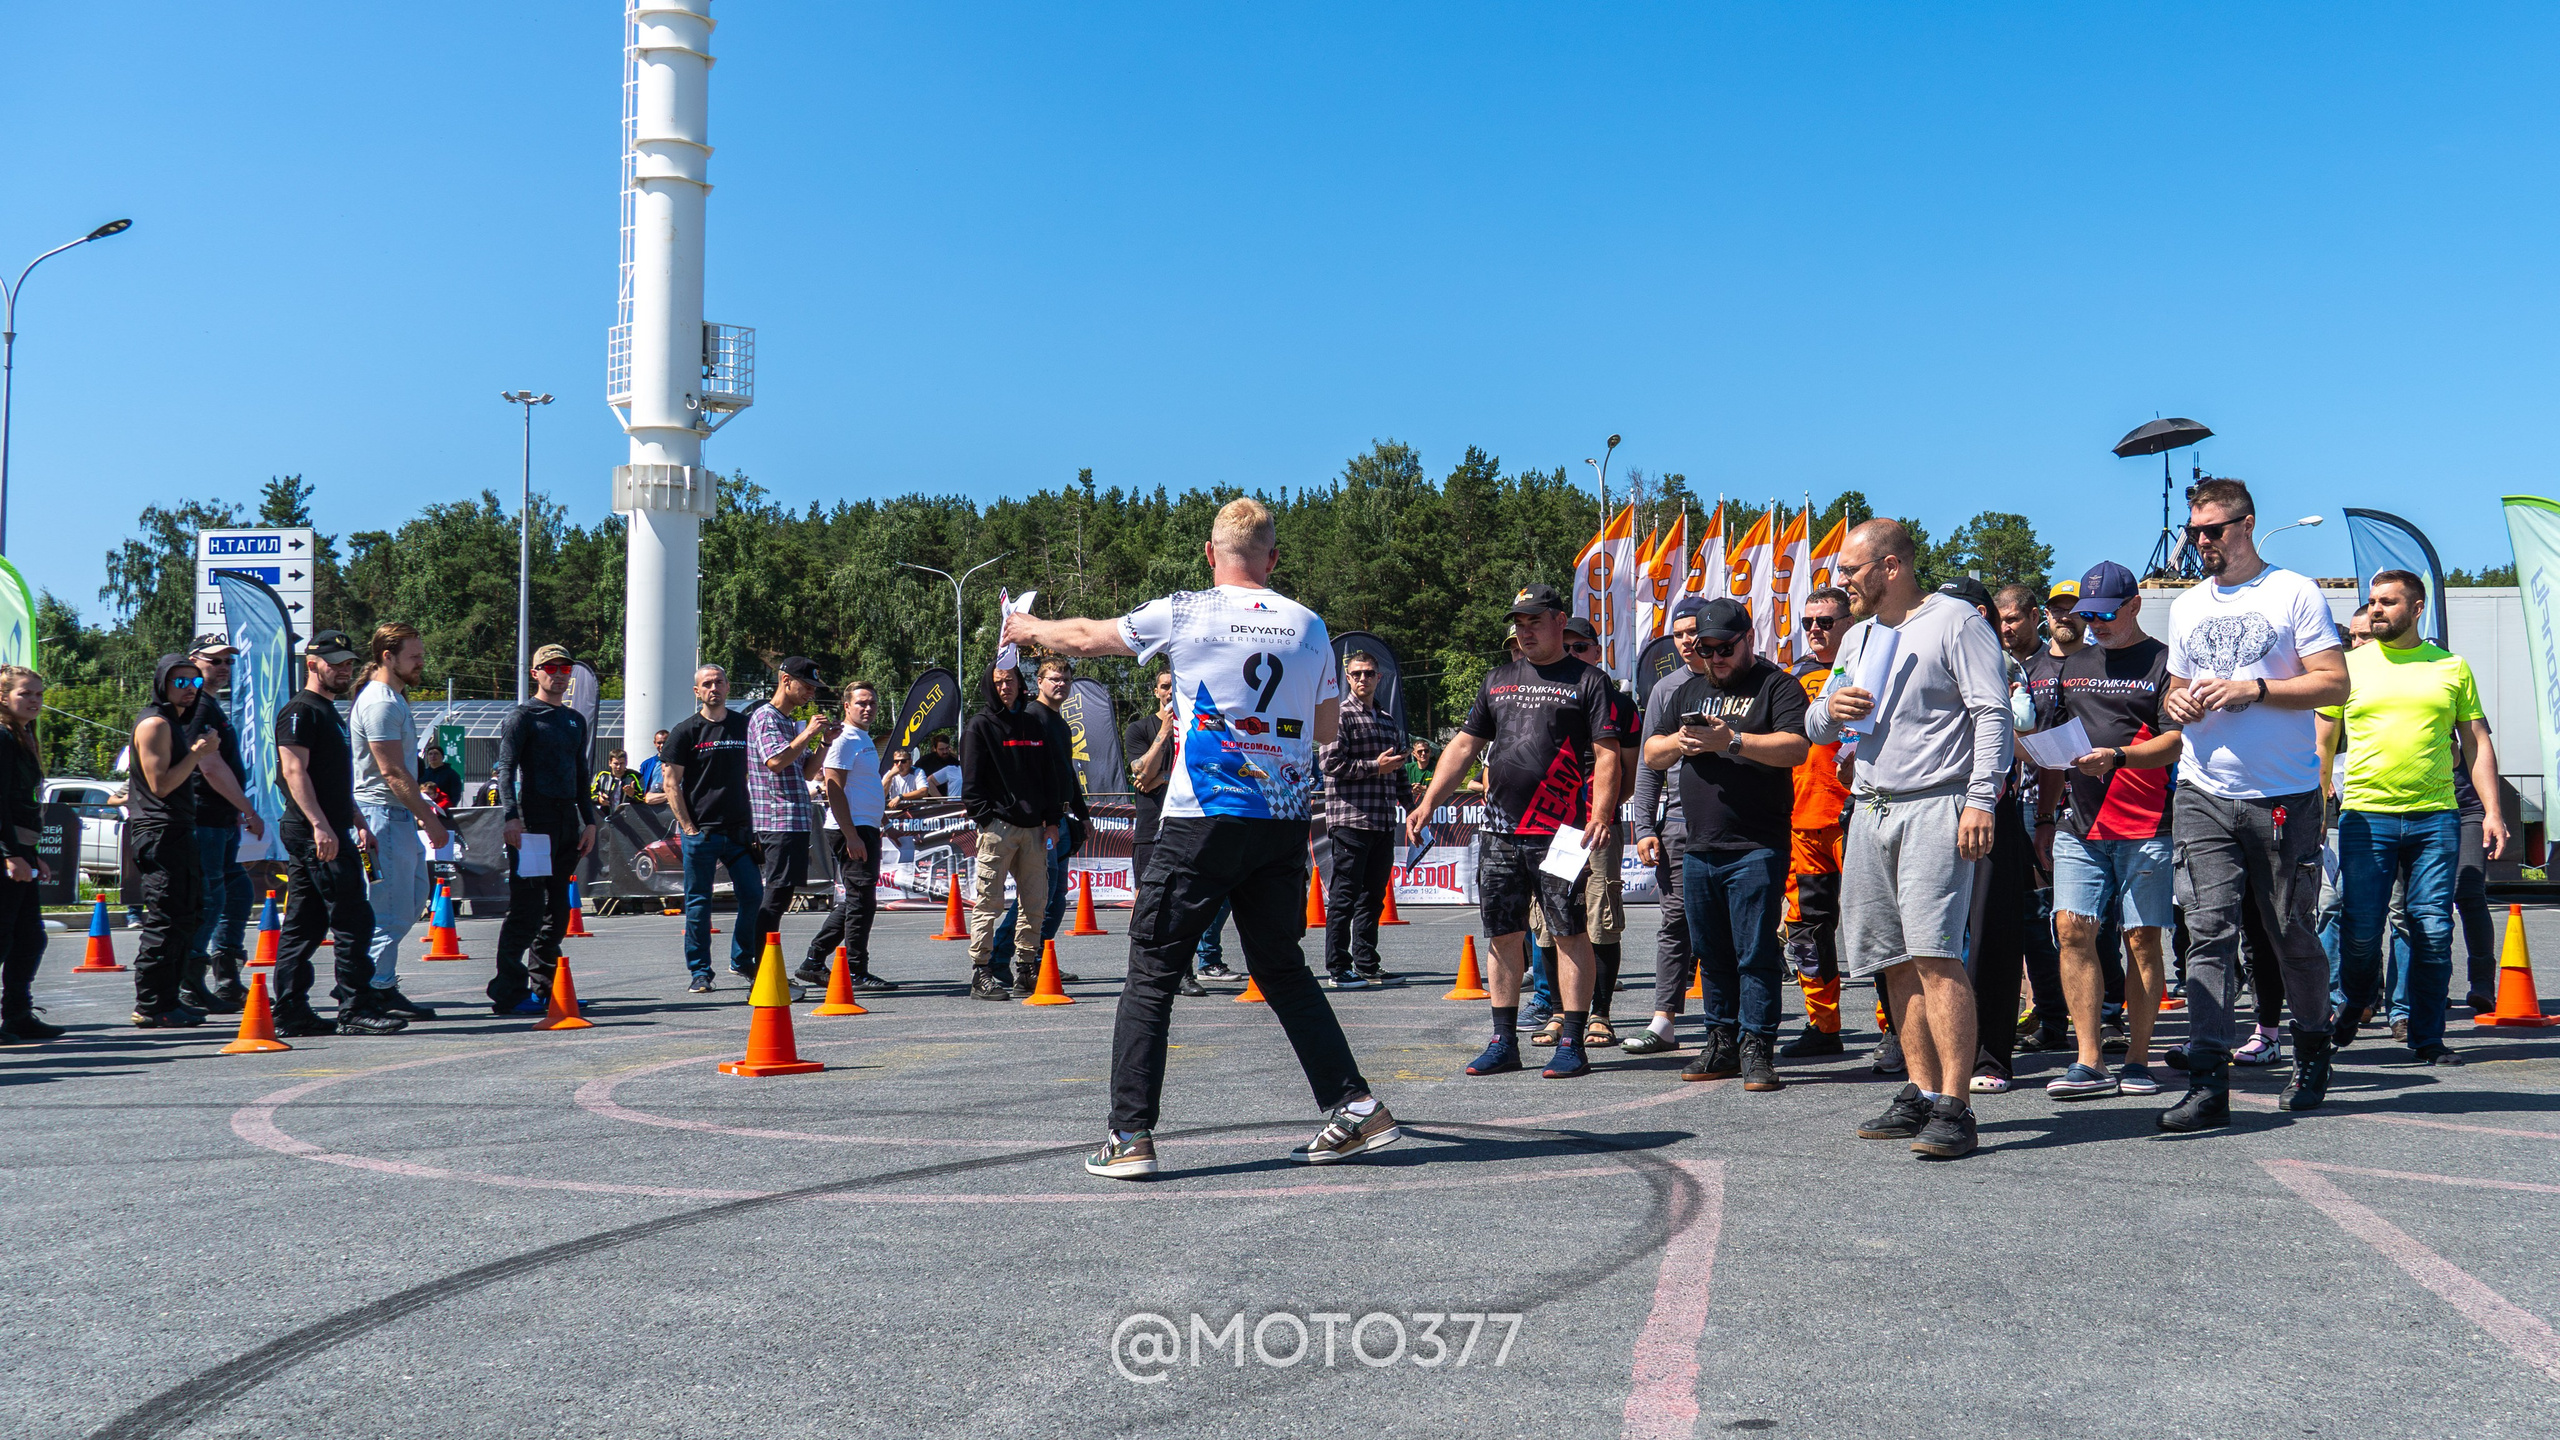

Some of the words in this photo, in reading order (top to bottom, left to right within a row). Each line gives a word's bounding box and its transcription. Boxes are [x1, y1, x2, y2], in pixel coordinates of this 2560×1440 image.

[210, 539, 278, 552] Н.ТАГИЛ
[1231, 624, 1296, 637] DEVYATKO
[1194, 636, 1292, 646] EKATERINBURG
[1299, 641, 1320, 655] TEAM
[1242, 652, 1284, 713] 9
[2062, 677, 2155, 692] MOTOGYMKHANA
[1490, 684, 1578, 700] MOTOGYMKHANA
[1495, 694, 1566, 705] EKATERINBURG
[1516, 701, 1541, 709] TEAM
[902, 683, 943, 747] VOLT
[1526, 757, 1582, 829] TEAM
[1393, 862, 1464, 894] PEEDOL
